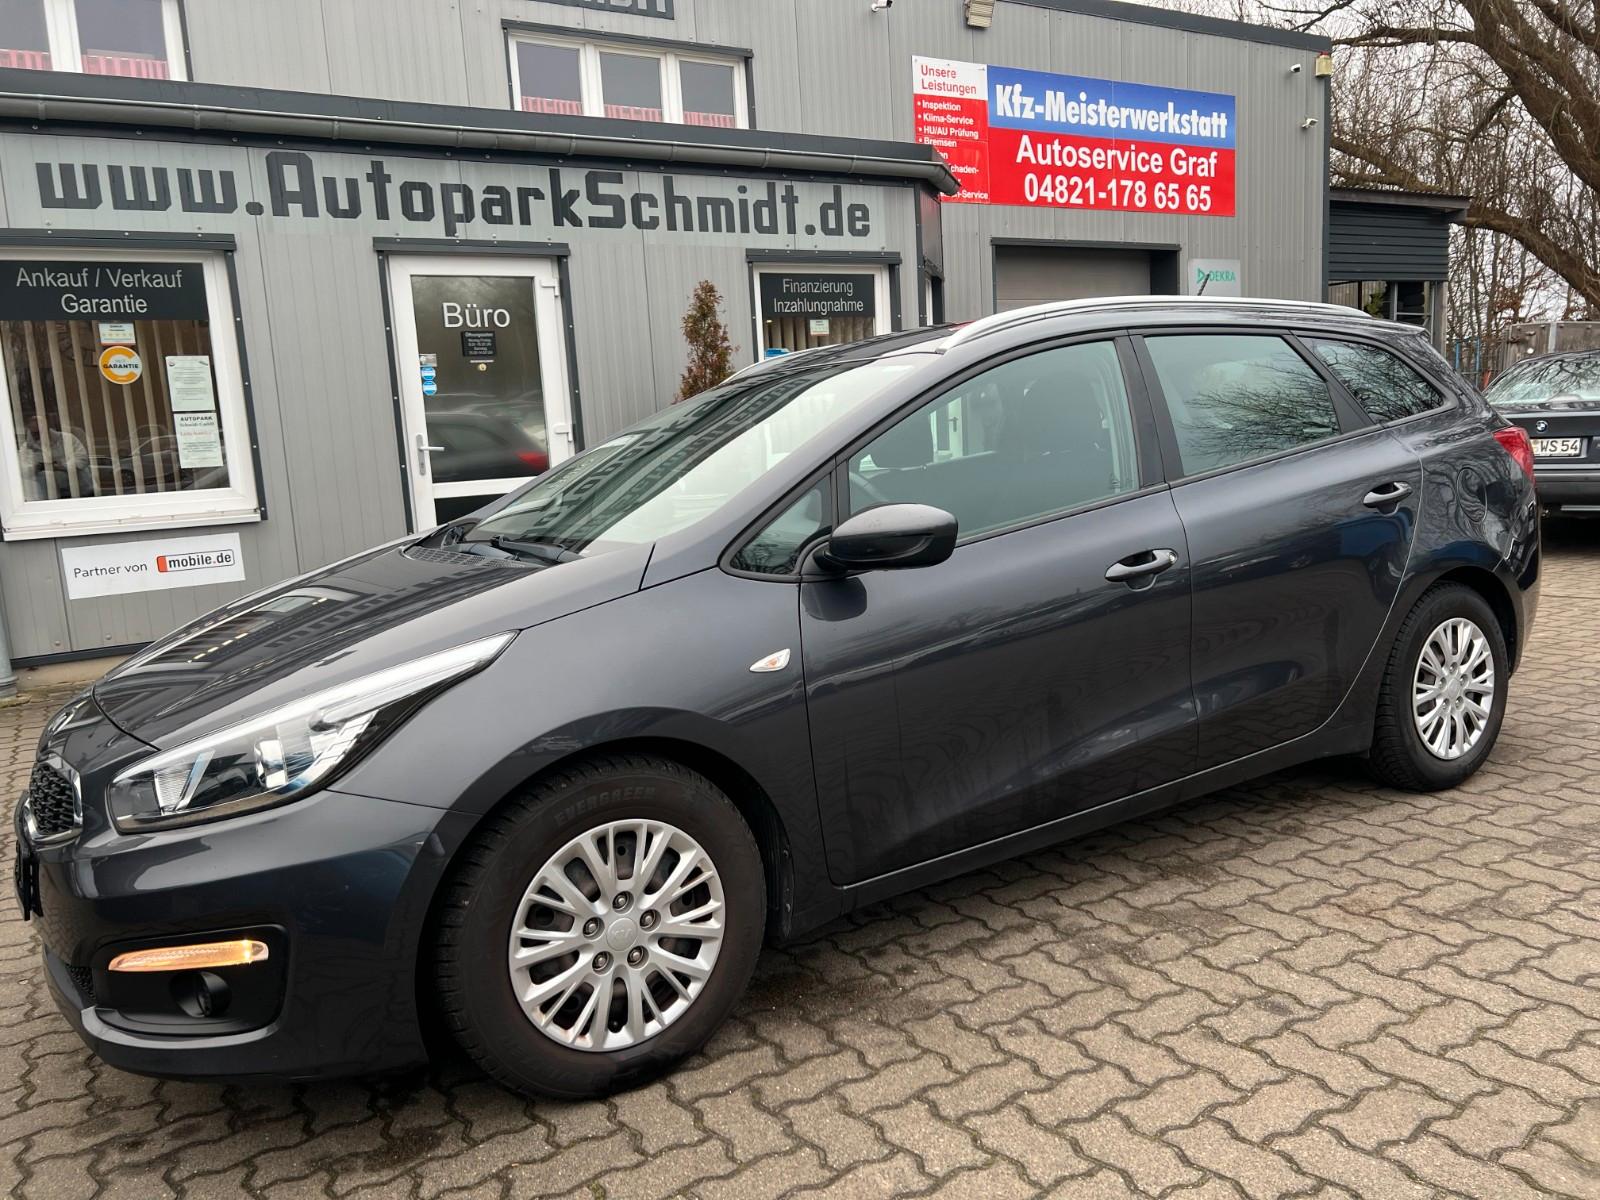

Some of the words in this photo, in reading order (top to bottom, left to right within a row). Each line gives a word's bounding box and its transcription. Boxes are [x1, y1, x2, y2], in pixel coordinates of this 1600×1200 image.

[921, 65, 957, 79] Unsere
[921, 79, 977, 96] Leistungen
[922, 100, 961, 112] Inspektion
[995, 83, 1228, 139] Kfz-Meisterwerkstatt
[923, 112, 974, 126] Klima-Service
[923, 126, 948, 136] HU/AU
[950, 128, 979, 140] Prüfung
[923, 137, 957, 148] Bremsen
[1016, 134, 1163, 174] Autoservice
[1170, 148, 1218, 178] Graf
[35, 151, 870, 237] www.AutoparkSchmidt.de
[1024, 173, 1147, 208] 04821-178
[1154, 182, 1180, 210] 65
[1186, 184, 1212, 212] 65
[16, 267, 88, 288] Ankauf
[95, 268, 101, 288] /
[106, 268, 182, 288] Verkauf
[1209, 270, 1236, 282] DEKRA
[782, 278, 854, 297] Finanzierung
[61, 293, 148, 314] Garantie
[773, 297, 864, 316] Inzahlungnahme
[442, 302, 511, 328] Büro
[1540, 440, 1559, 452] WS
[1560, 439, 1579, 452] 54
[73, 565, 121, 579] Partner
[124, 562, 149, 574] von
[168, 552, 232, 569] mobile.de
